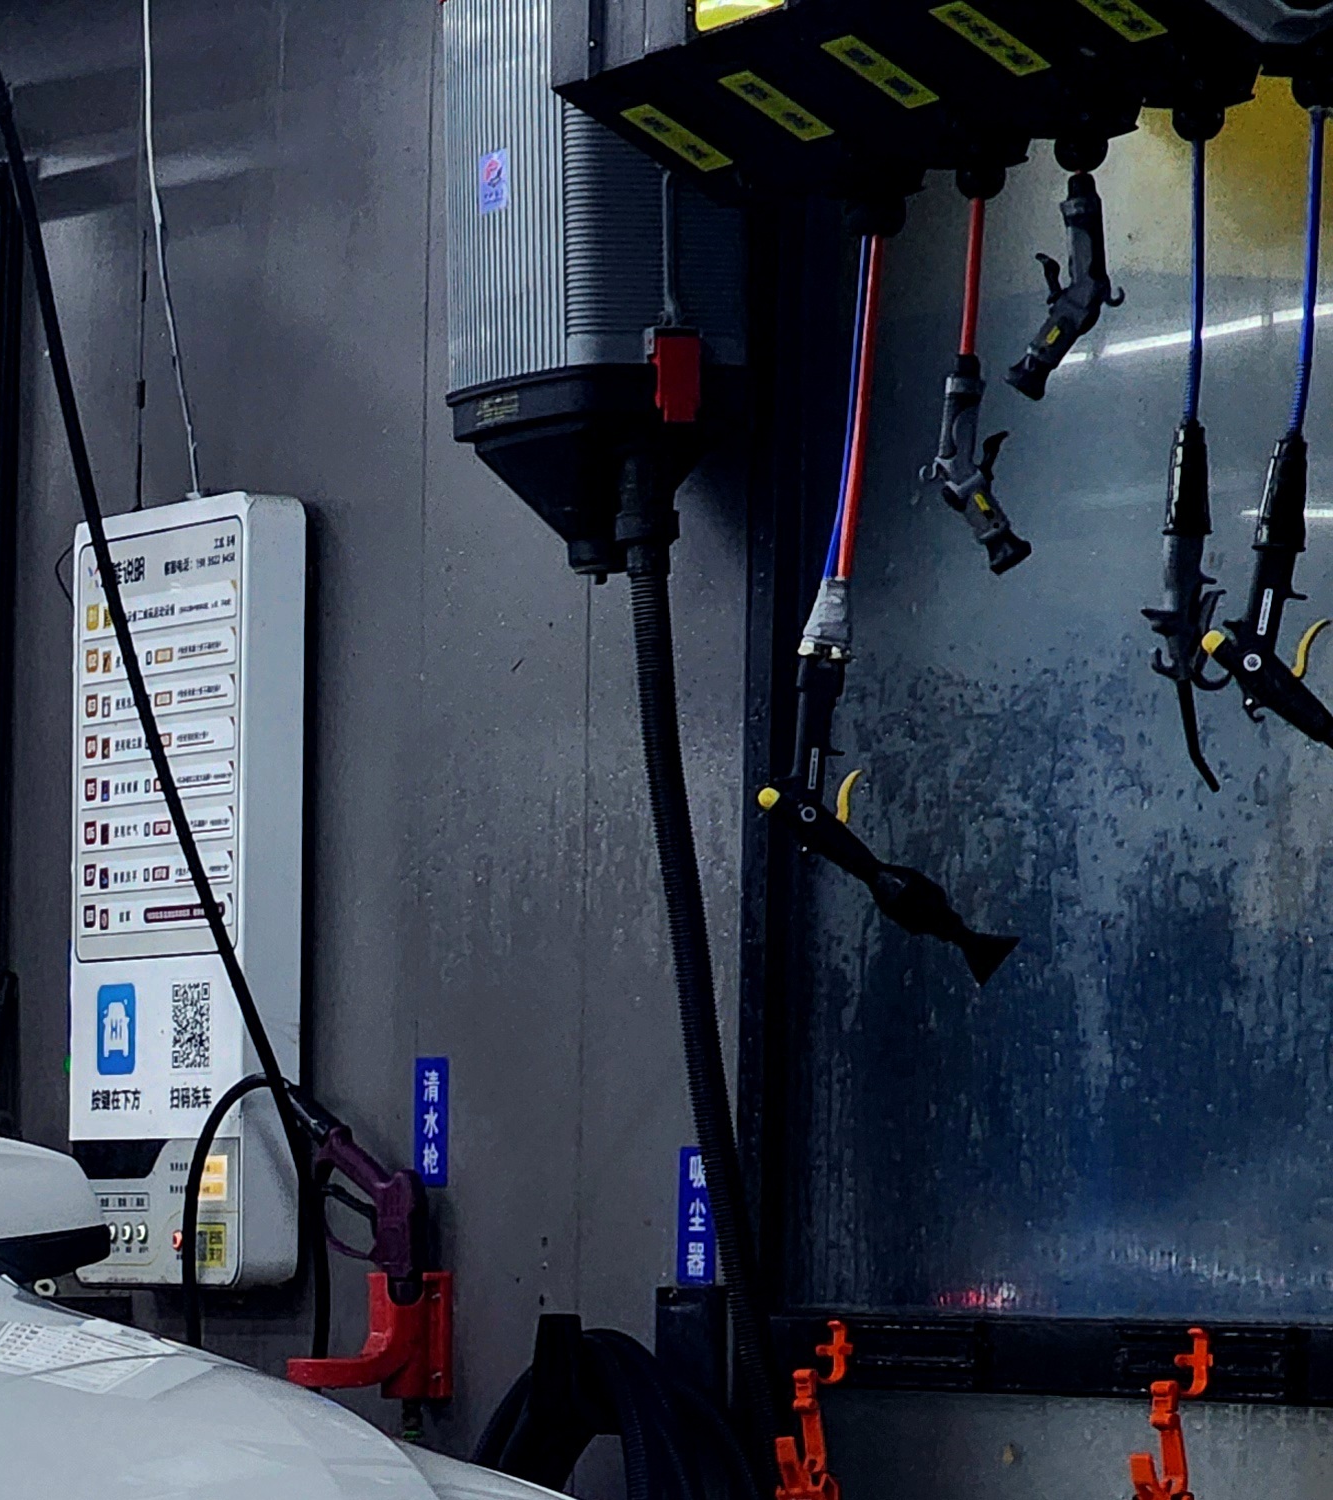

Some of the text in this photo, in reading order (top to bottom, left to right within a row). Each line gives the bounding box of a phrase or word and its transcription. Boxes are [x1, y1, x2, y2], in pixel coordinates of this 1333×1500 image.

[109, 1016, 123, 1039] Hi
[91, 1087, 141, 1111] 按键在下方
[170, 1086, 213, 1109] 扫码洗车
[422, 1069, 440, 1175] 清水枪
[686, 1154, 707, 1278] 吸尘器
